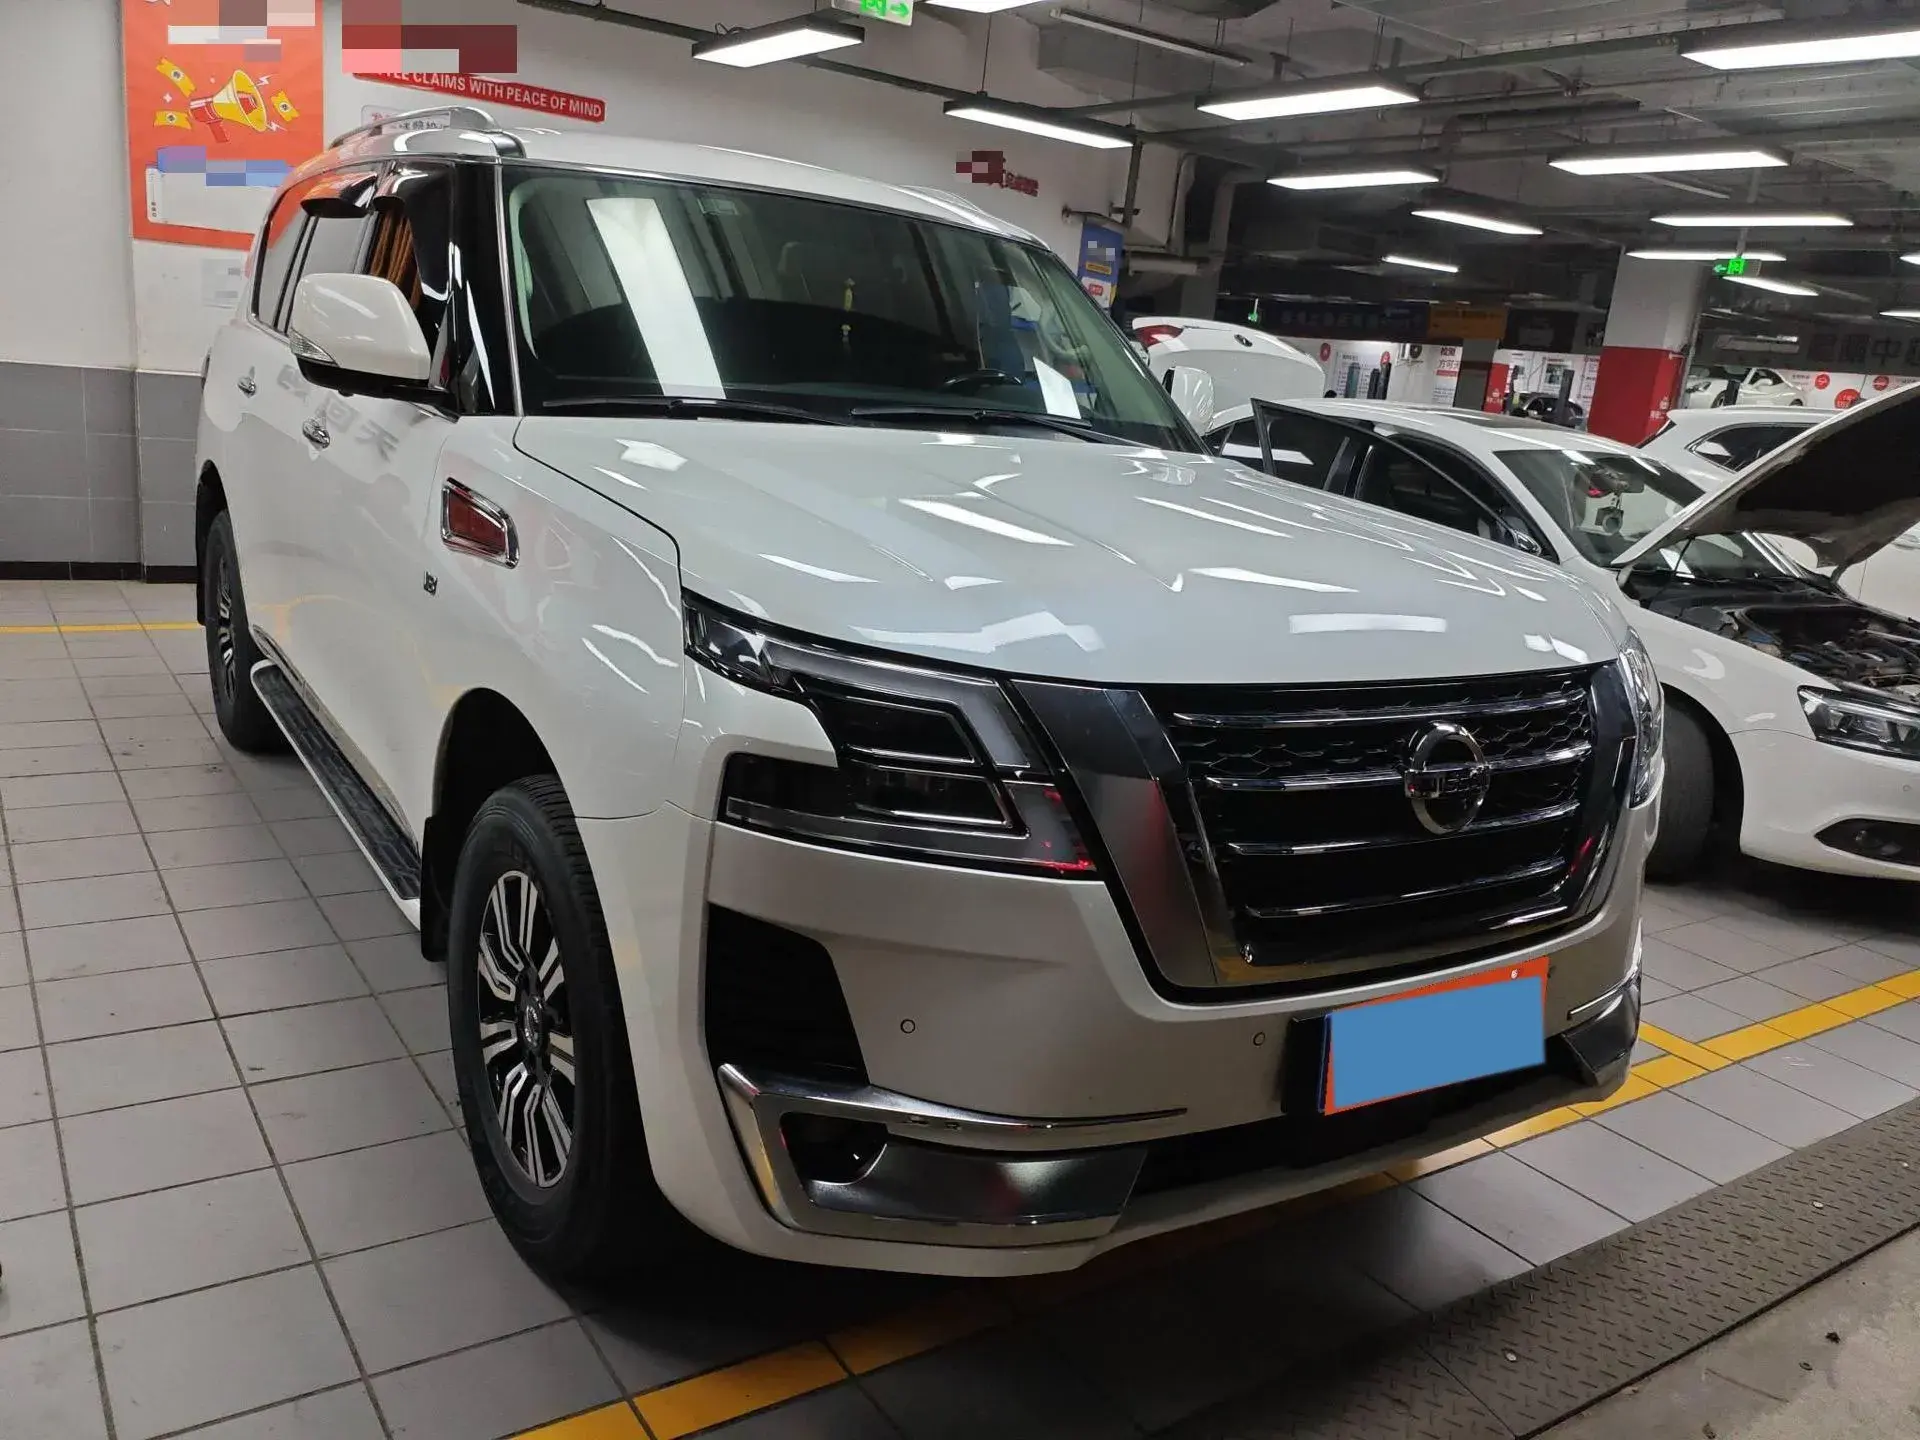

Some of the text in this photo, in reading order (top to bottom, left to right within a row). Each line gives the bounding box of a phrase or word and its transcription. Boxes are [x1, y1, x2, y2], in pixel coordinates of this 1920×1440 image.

[412, 71, 466, 91] CLAIMS
[469, 77, 504, 99] WITH
[506, 86, 548, 107] PEACE
[550, 95, 567, 110] OF
[569, 99, 601, 118] MIND
